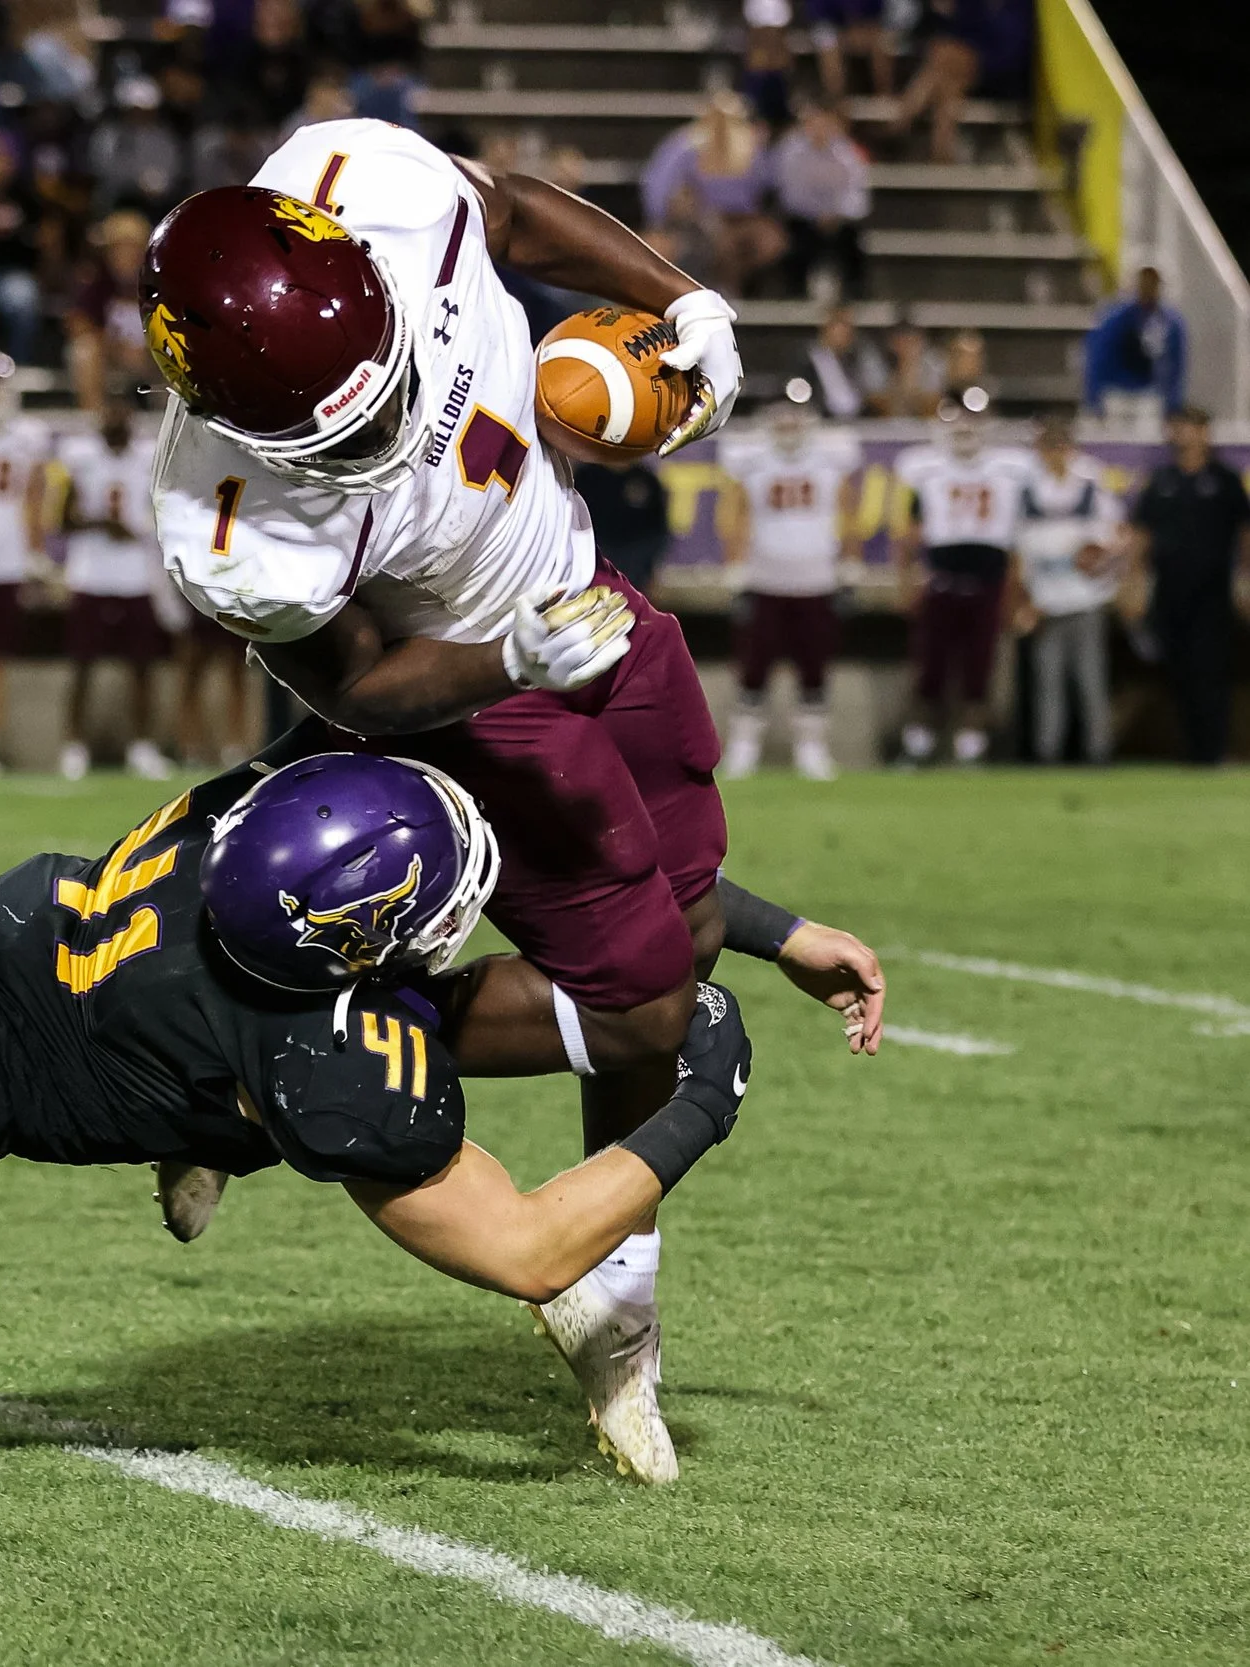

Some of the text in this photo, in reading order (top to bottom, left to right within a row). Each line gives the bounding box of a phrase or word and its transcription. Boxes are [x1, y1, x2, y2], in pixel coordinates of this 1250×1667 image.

[321, 369, 372, 418] Riddell
[425, 364, 474, 467] BULLDOGS
[211, 475, 246, 556] 1
[53, 788, 188, 997] 41
[361, 1011, 427, 1101] 41
